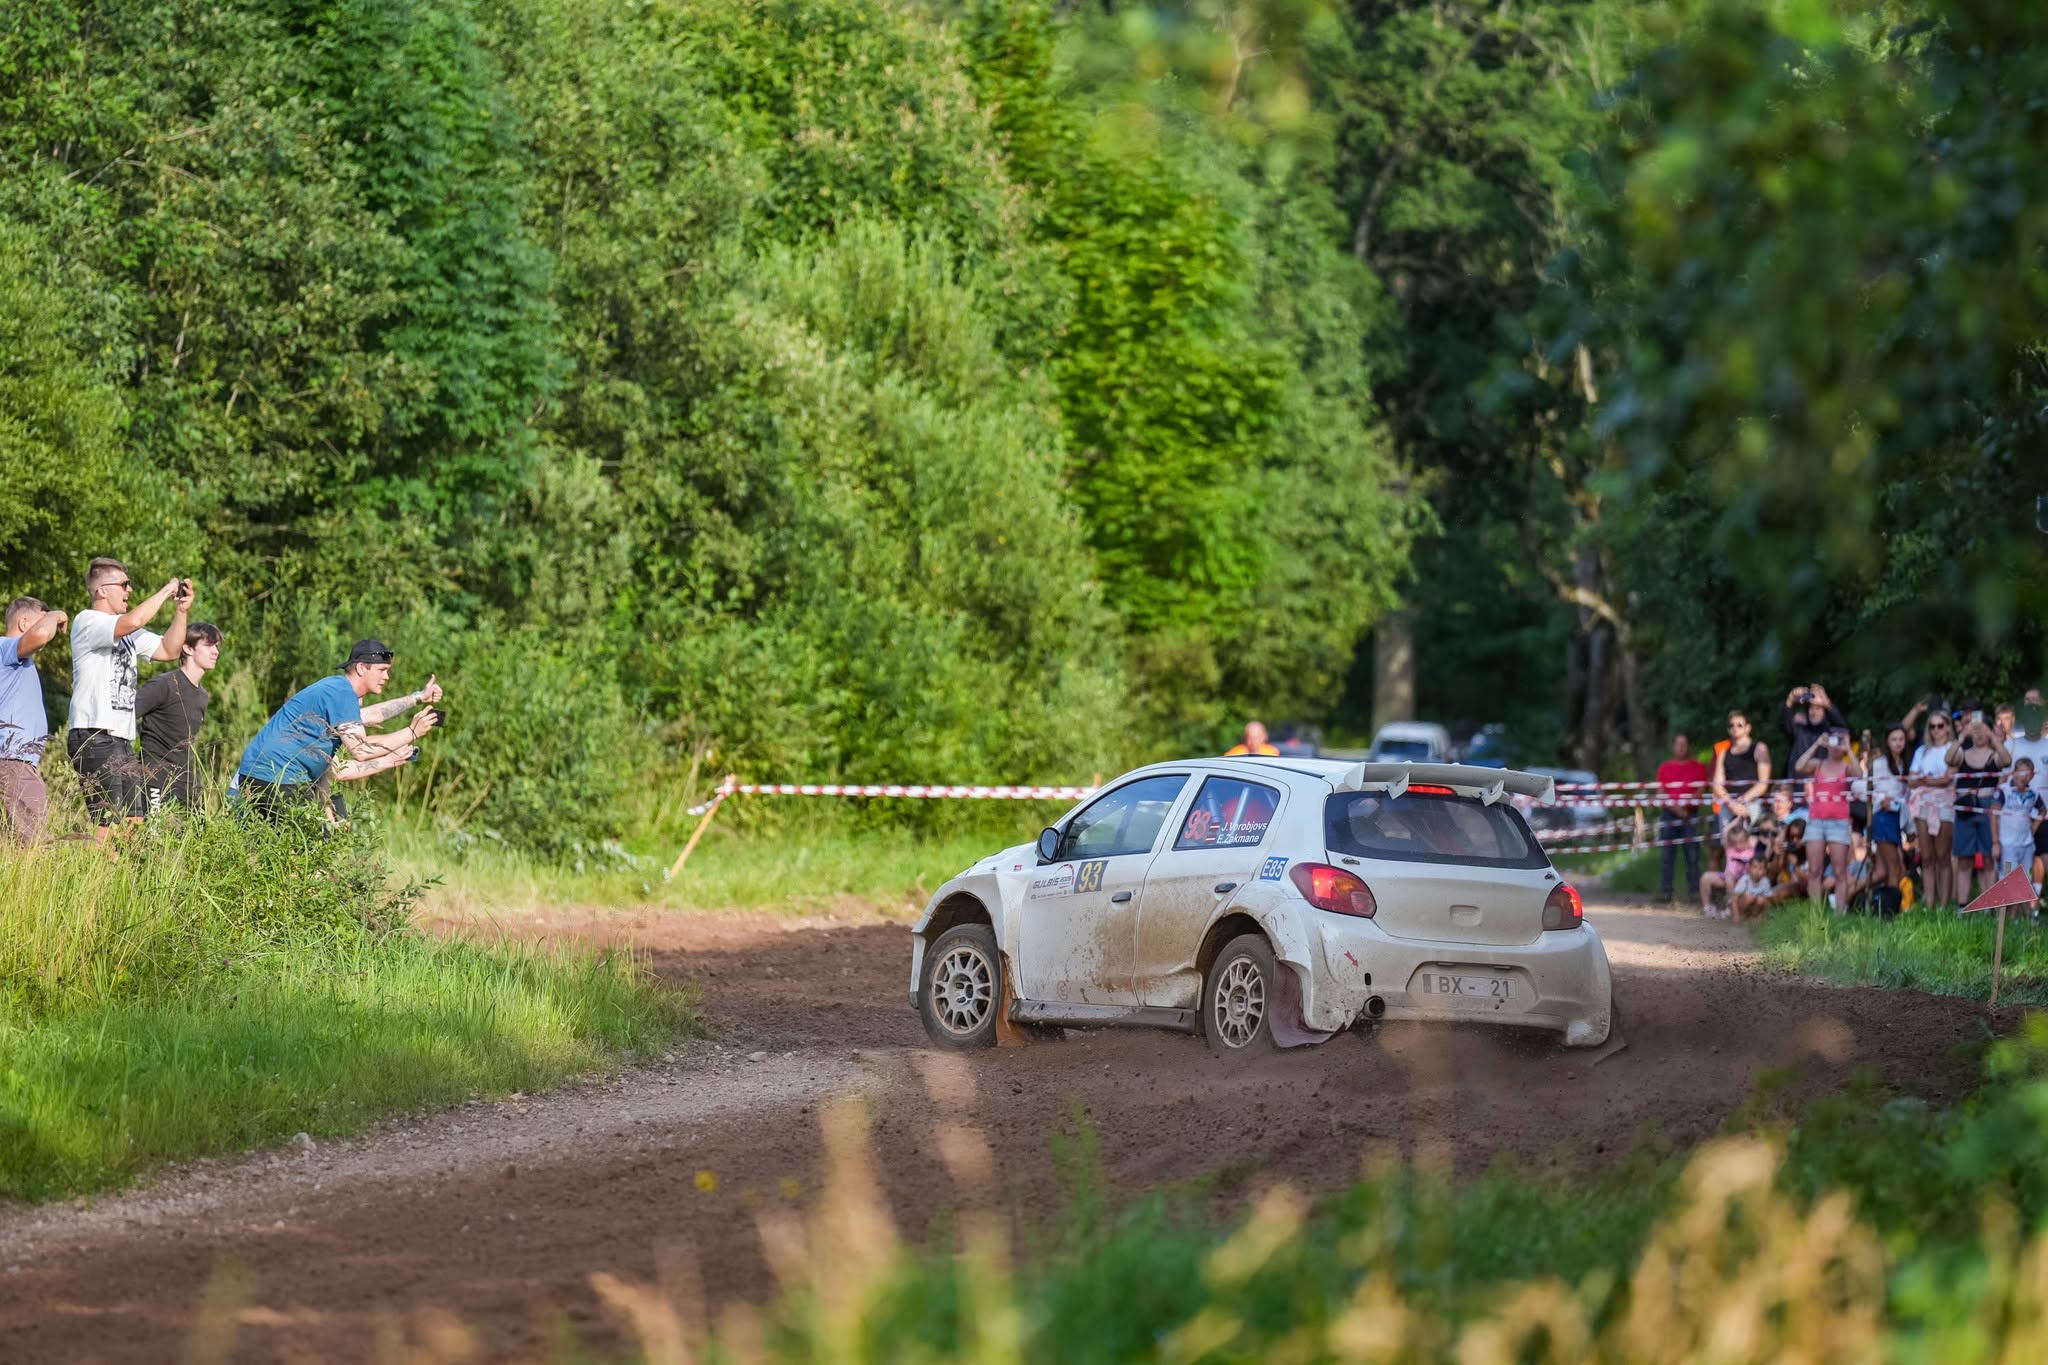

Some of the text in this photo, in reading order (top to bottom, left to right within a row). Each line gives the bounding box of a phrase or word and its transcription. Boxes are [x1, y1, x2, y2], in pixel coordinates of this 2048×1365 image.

[1184, 809, 1212, 840] 93
[1078, 861, 1103, 892] 93
[1261, 859, 1285, 878] E85
[1439, 976, 1463, 994] BX
[1490, 979, 1510, 997] 21
